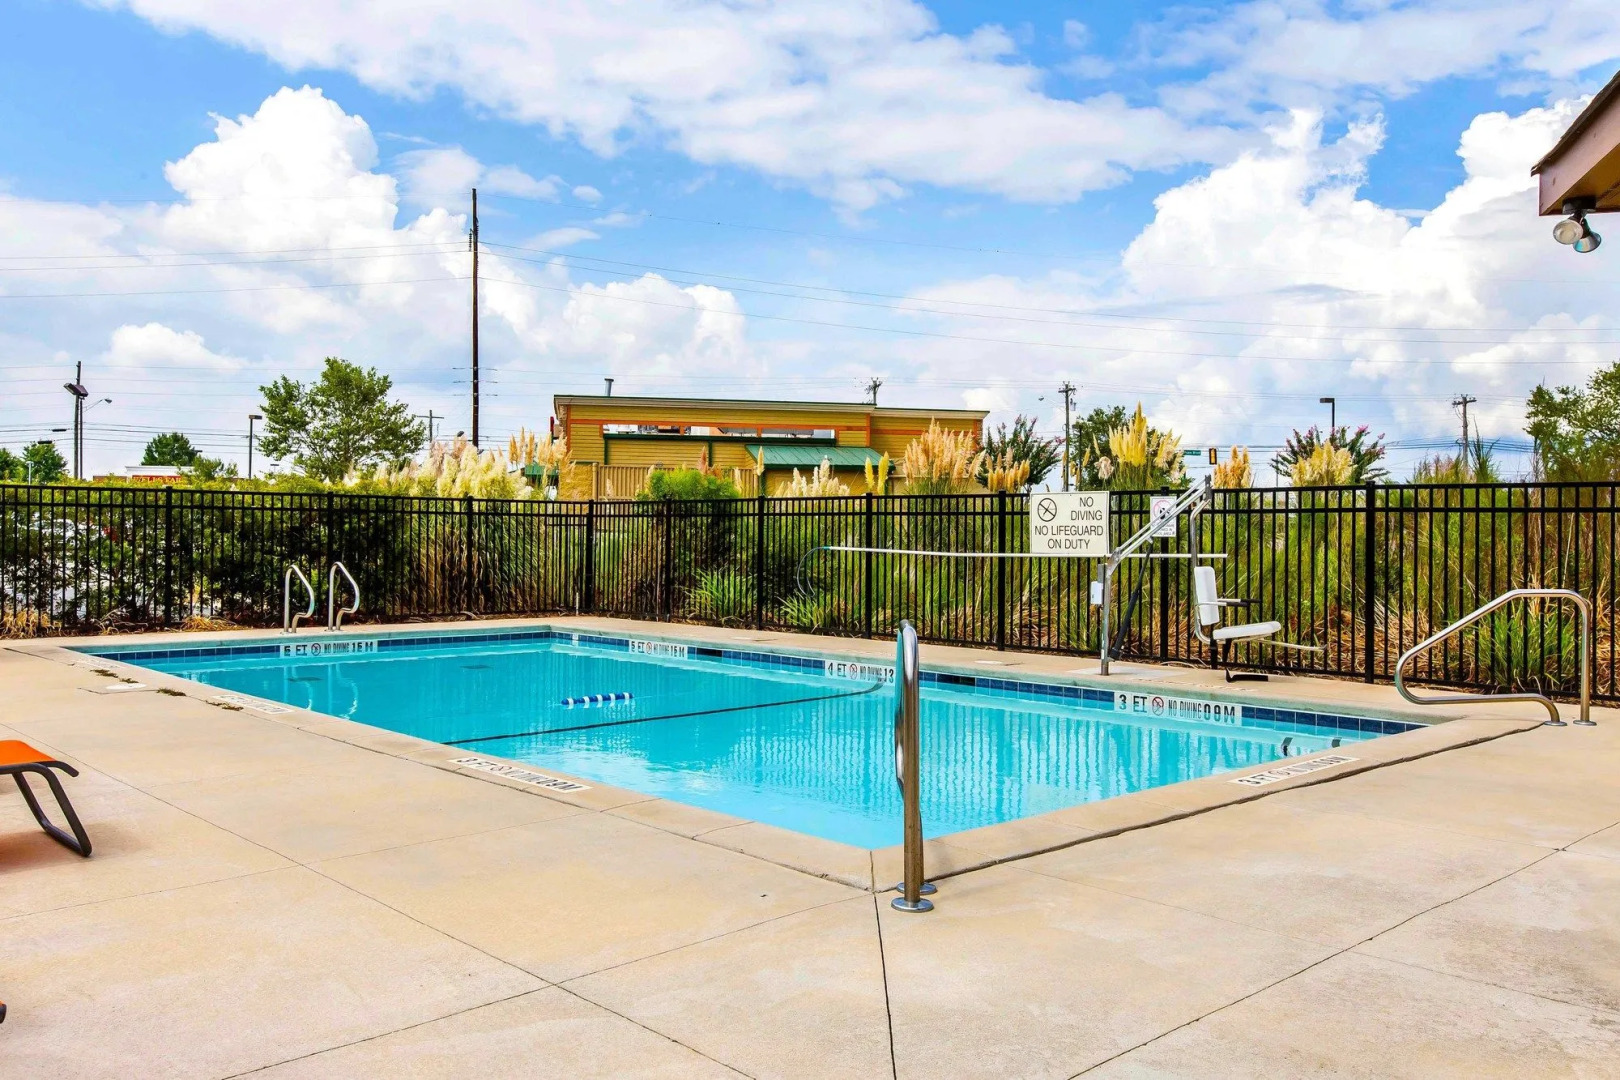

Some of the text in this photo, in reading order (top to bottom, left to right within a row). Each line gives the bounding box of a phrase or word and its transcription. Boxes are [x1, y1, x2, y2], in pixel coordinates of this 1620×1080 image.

[1080, 496, 1094, 507] NO
[1070, 510, 1102, 520] DIVING
[1034, 525, 1104, 536] NO LIFEGUARD
[1048, 538, 1090, 550] ON DUTY
[284, 645, 291, 656] 5
[324, 643, 332, 654] NO
[333, 642, 349, 653] DIVING
[860, 665, 866, 680] NO
[1119, 694, 1127, 710] 3
[1133, 695, 1147, 713] FT
[1168, 699, 1177, 716] NO
[1180, 701, 1202, 719] DIVING
